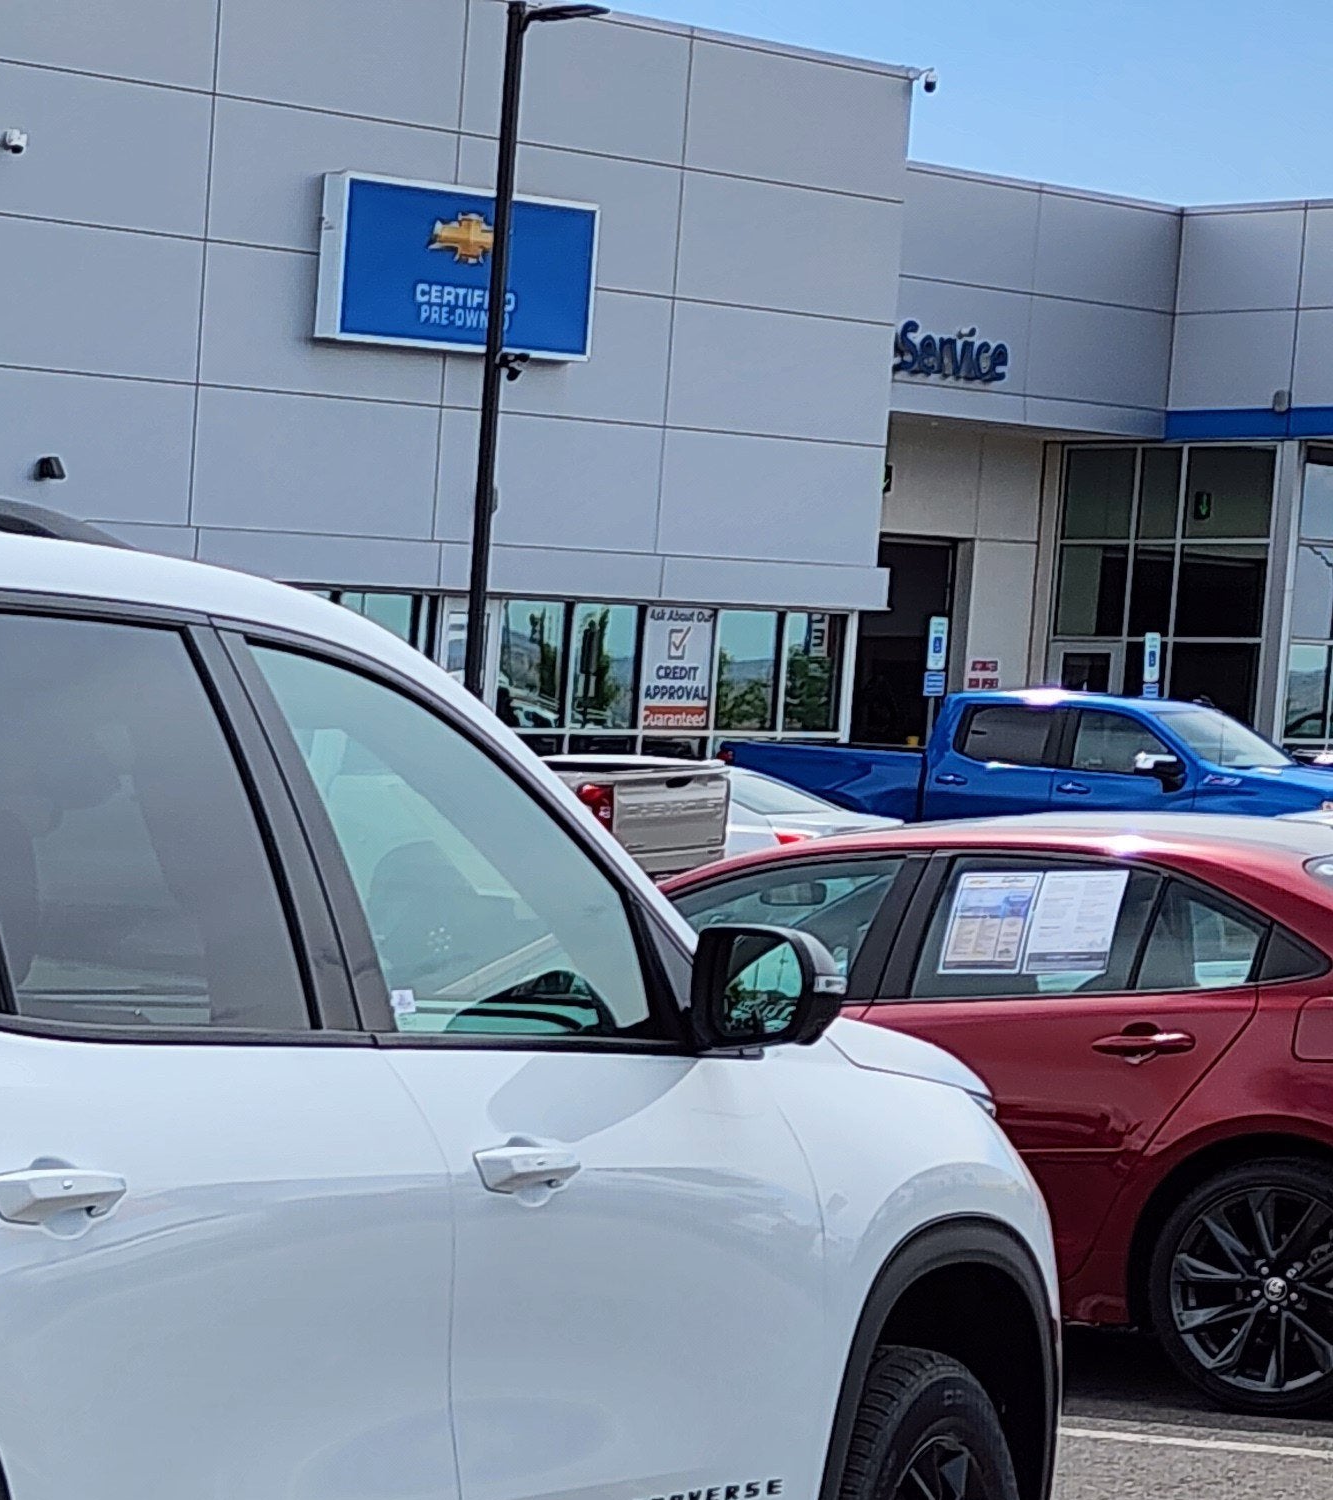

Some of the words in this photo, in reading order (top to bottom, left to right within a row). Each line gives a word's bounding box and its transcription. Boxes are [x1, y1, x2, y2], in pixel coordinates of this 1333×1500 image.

[416, 283, 516, 312] CERTIFID
[892, 320, 1008, 381] Service
[656, 665, 699, 681] CREDIT
[644, 685, 708, 701] APPROVAL
